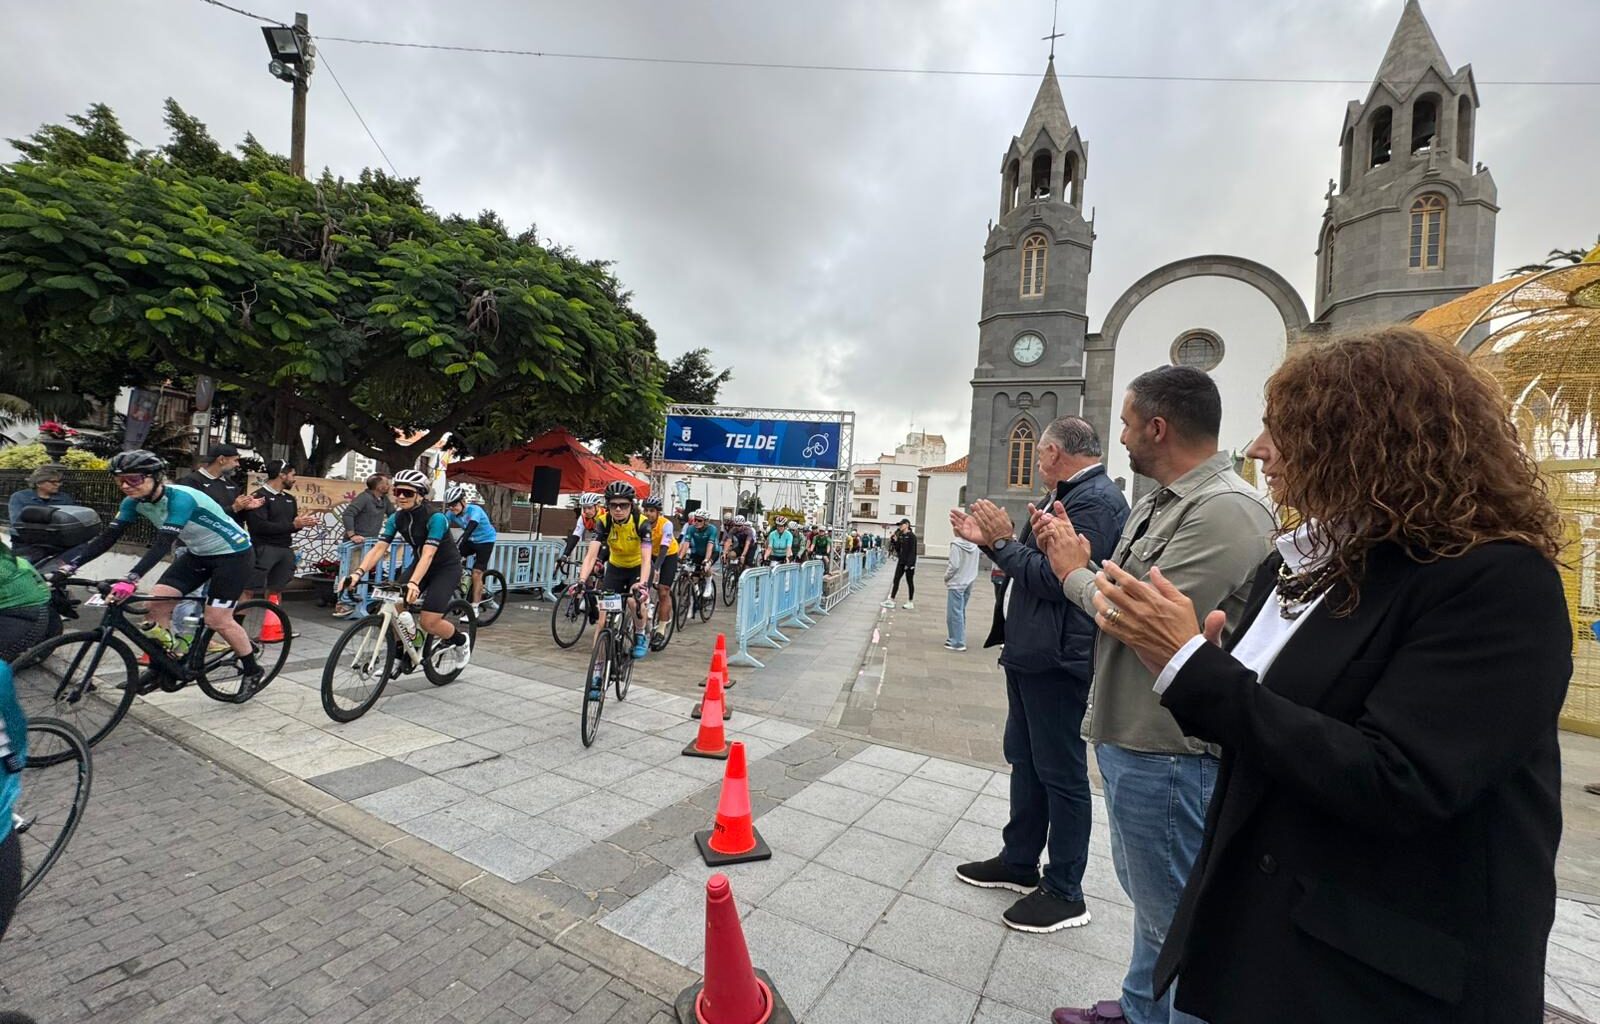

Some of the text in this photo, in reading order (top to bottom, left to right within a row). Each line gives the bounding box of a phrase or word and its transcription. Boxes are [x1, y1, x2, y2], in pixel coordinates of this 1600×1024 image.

[725, 433, 778, 450] TELDE
[198, 515, 234, 536] Gran Canaria
